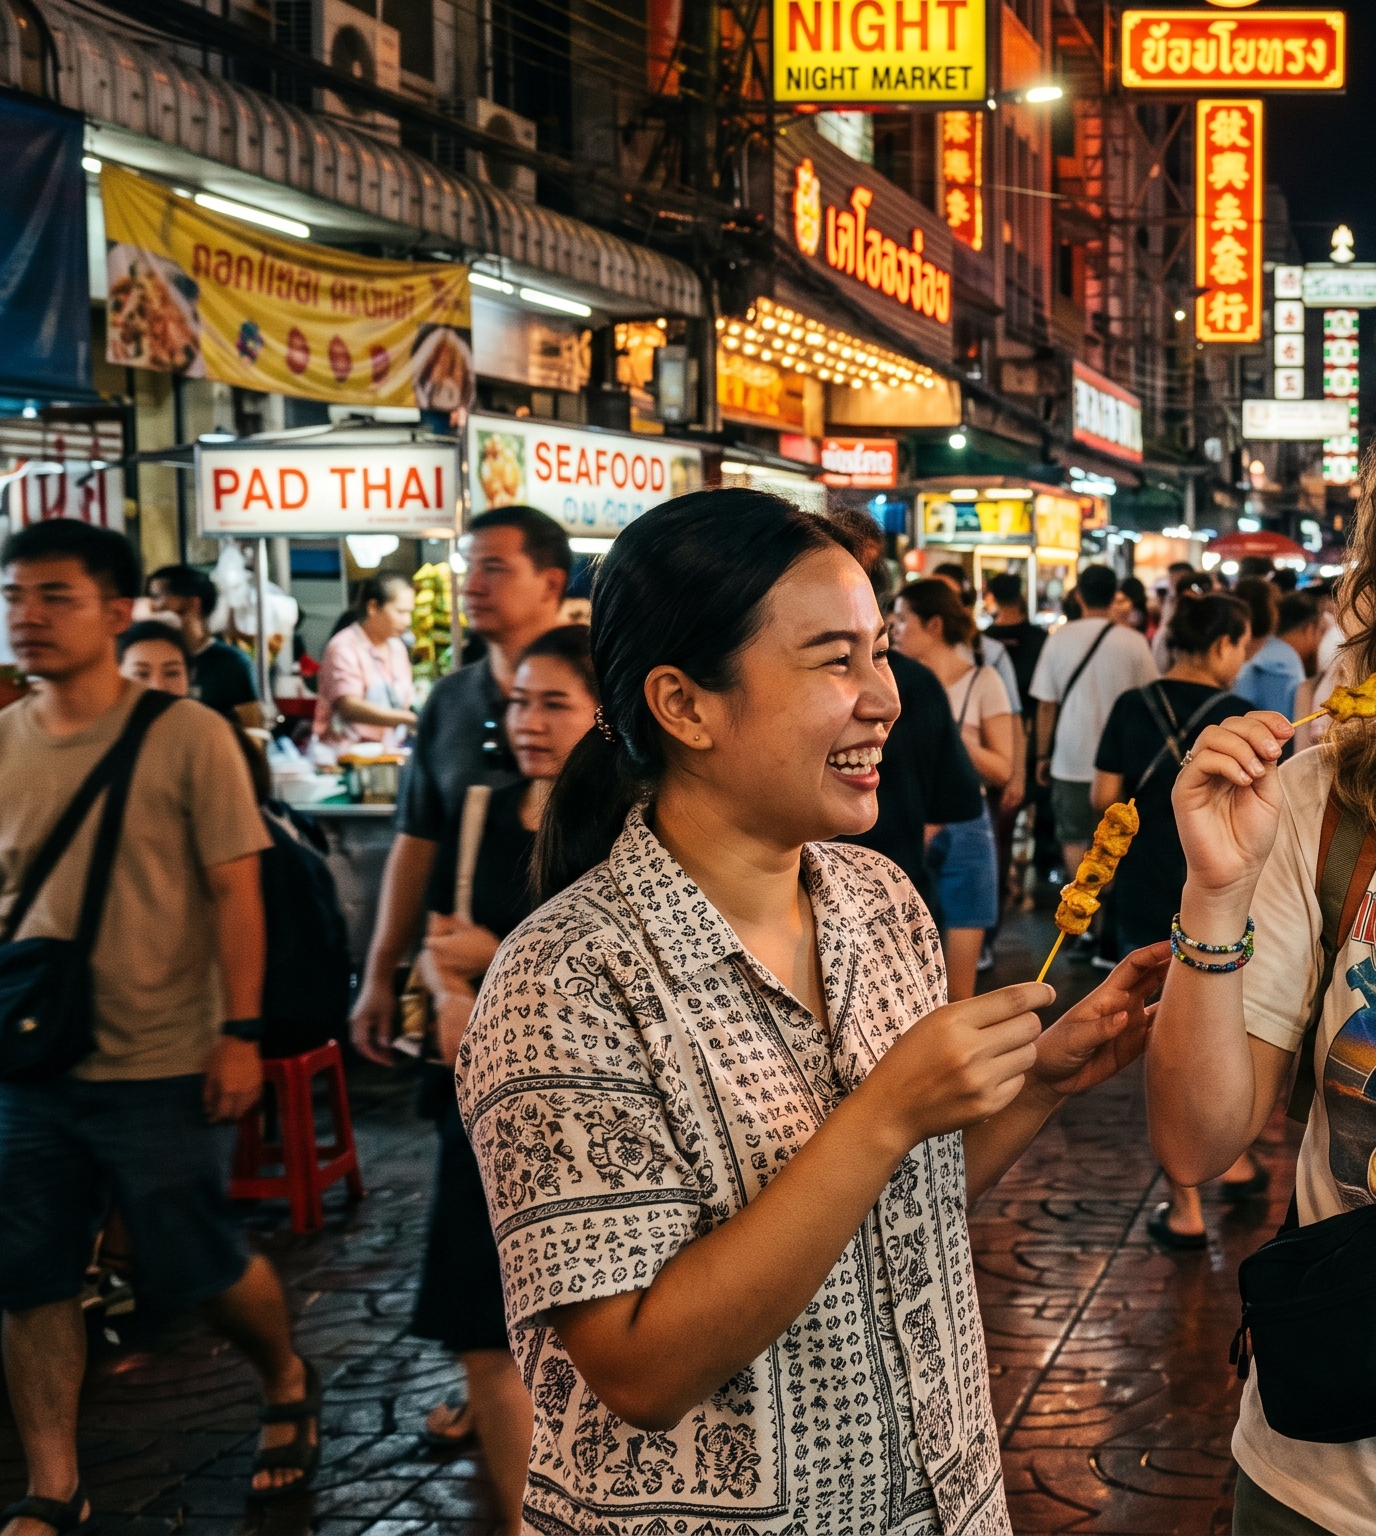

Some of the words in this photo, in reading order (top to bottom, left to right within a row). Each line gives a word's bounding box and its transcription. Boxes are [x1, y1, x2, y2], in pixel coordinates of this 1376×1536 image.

[787, 0, 966, 52] NIGHT
[786, 66, 859, 91] NIGHT
[871, 66, 972, 90] MARKET
[212, 465, 309, 513] PAD
[330, 465, 444, 511] THAI
[534, 440, 665, 492] SEAFOOD
